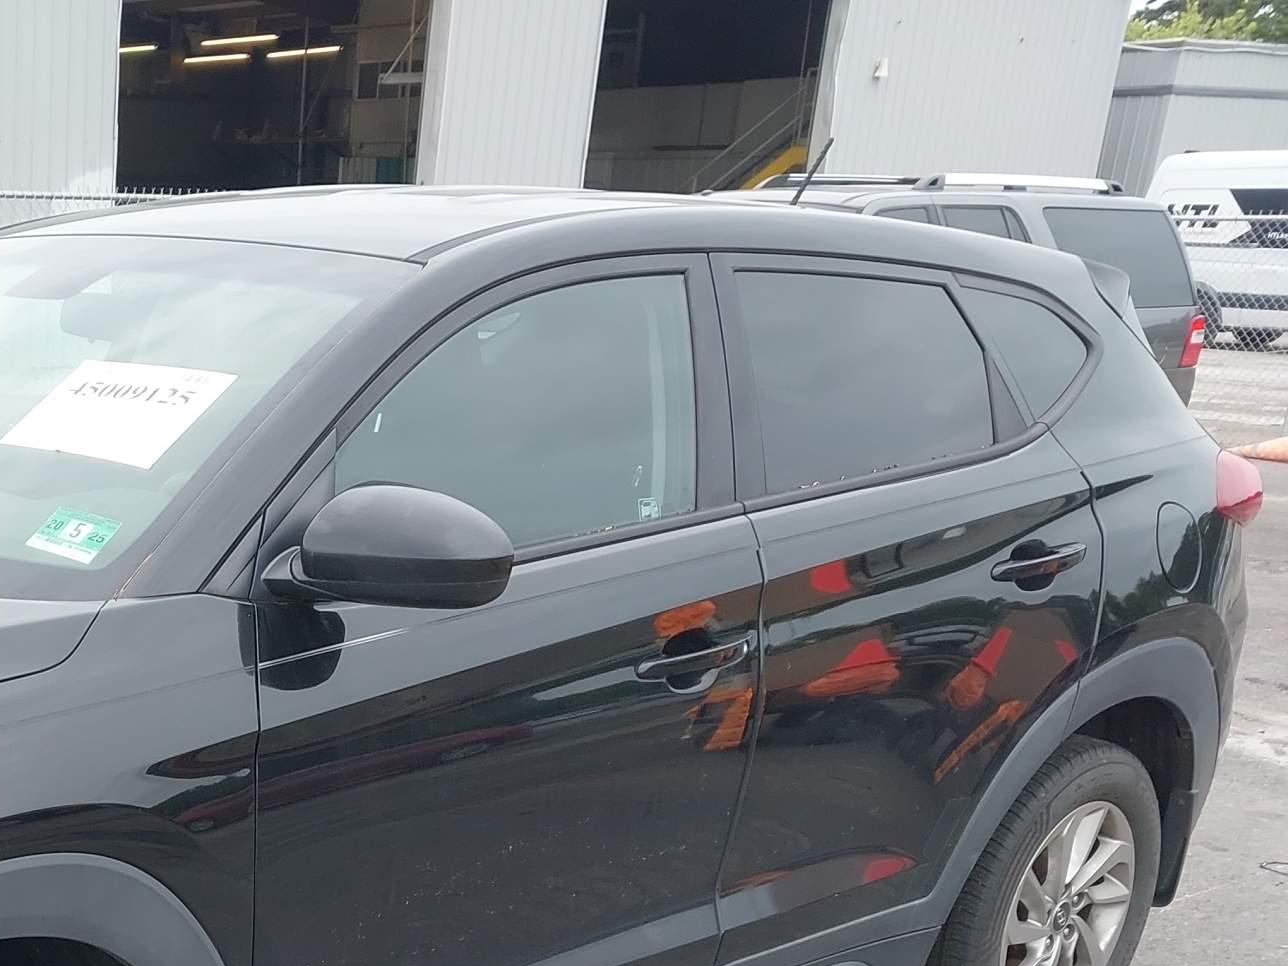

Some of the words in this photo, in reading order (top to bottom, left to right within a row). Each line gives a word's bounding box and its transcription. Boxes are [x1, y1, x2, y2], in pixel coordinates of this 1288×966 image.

[69, 382, 197, 406] 45009125
[46, 519, 65, 531] 20
[69, 522, 87, 538] 5
[87, 532, 107, 543] 25
